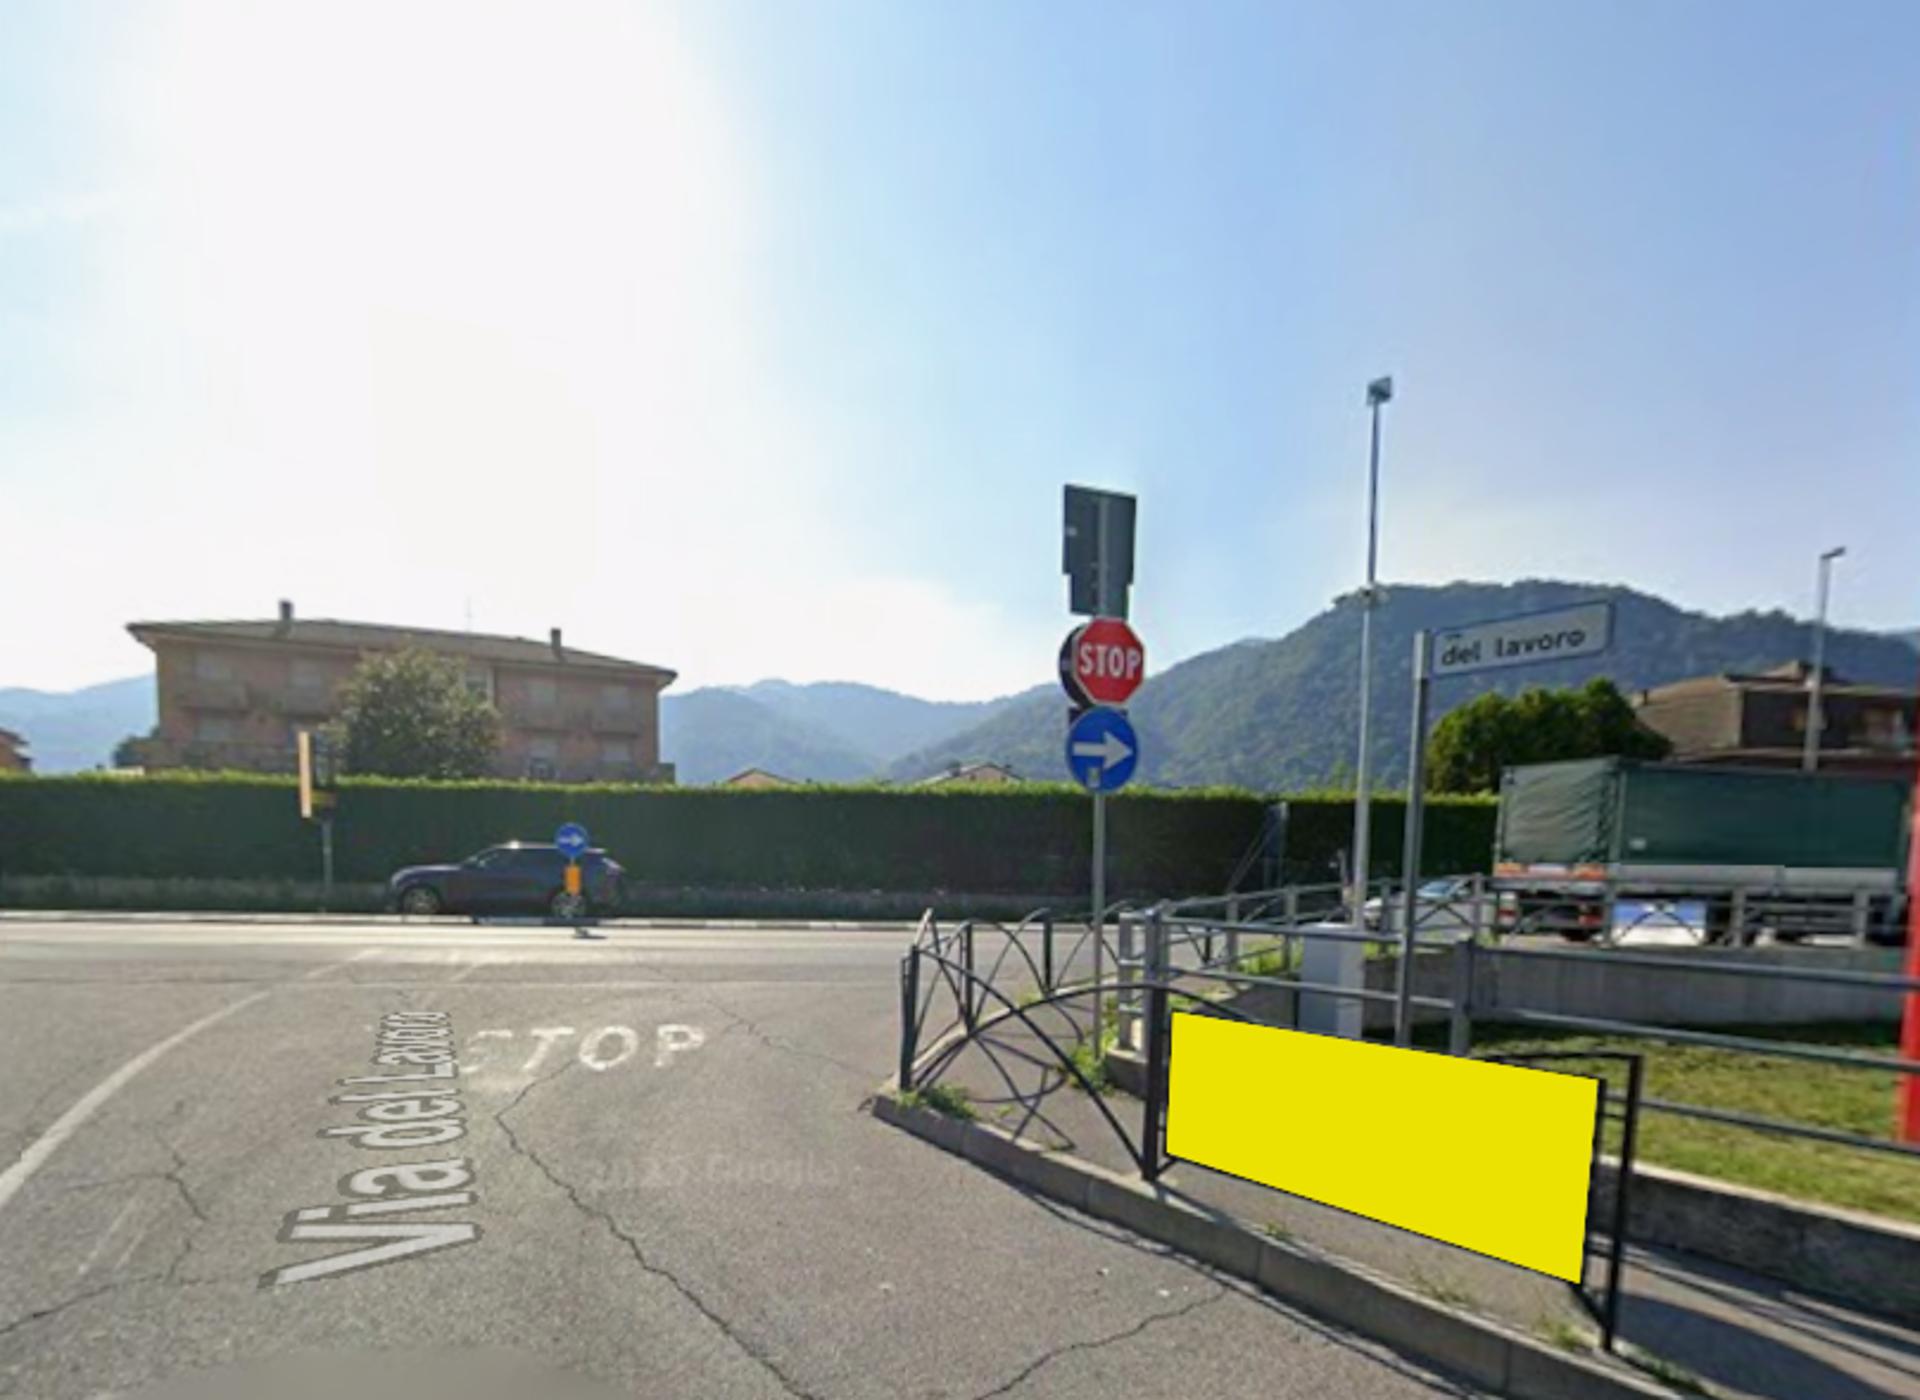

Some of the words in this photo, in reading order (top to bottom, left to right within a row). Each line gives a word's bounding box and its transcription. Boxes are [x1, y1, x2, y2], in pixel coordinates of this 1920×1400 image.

[1079, 643, 1141, 680] STOP
[1441, 640, 1481, 666] del
[1496, 628, 1586, 657] lavoro
[460, 1022, 706, 1075] STOP
